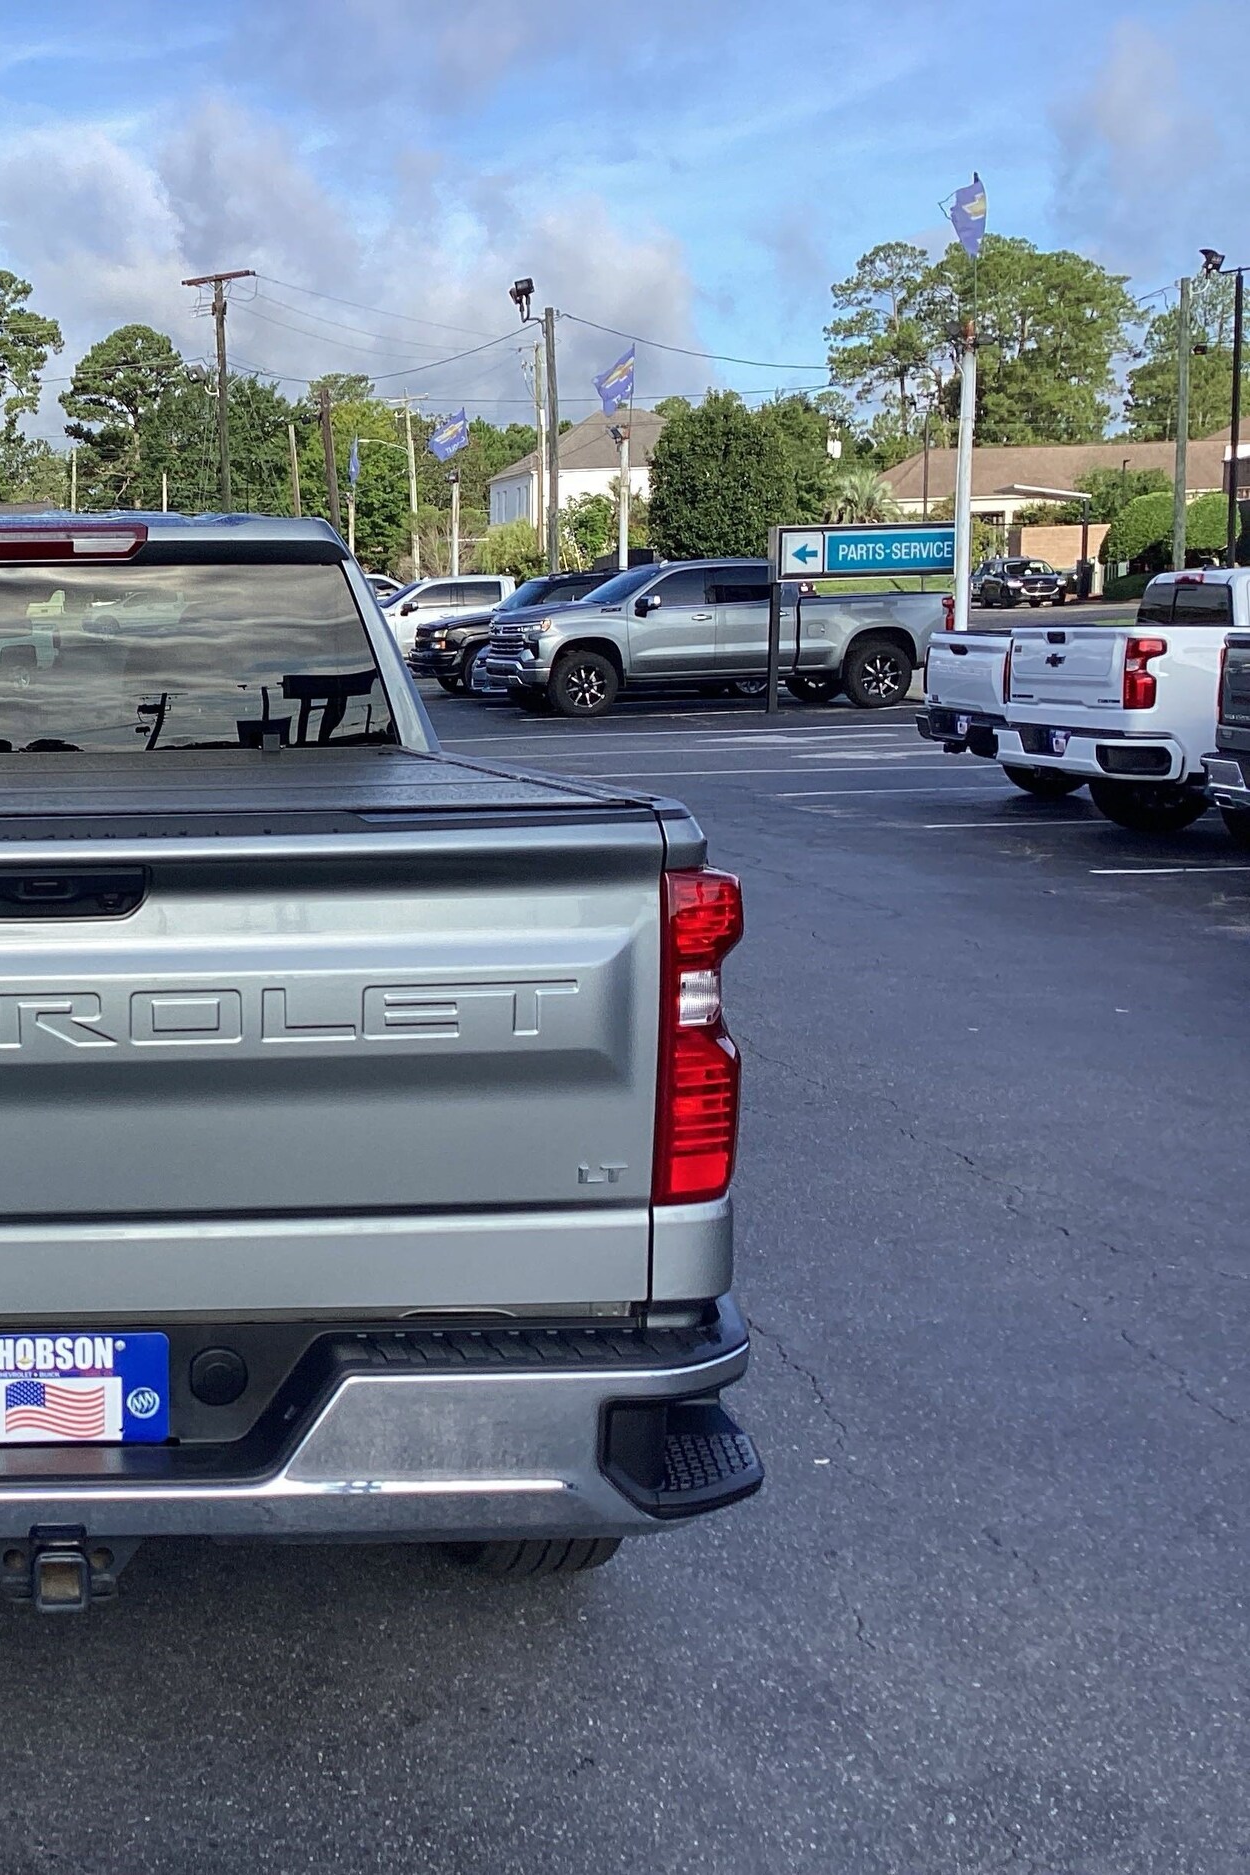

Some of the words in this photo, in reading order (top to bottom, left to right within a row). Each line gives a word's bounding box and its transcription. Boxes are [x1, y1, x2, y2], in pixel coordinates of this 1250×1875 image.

[838, 541, 953, 561] PARTS-SERVICE
[577, 1162, 629, 1184] LT
[39, 1370, 61, 1378] BUICK
